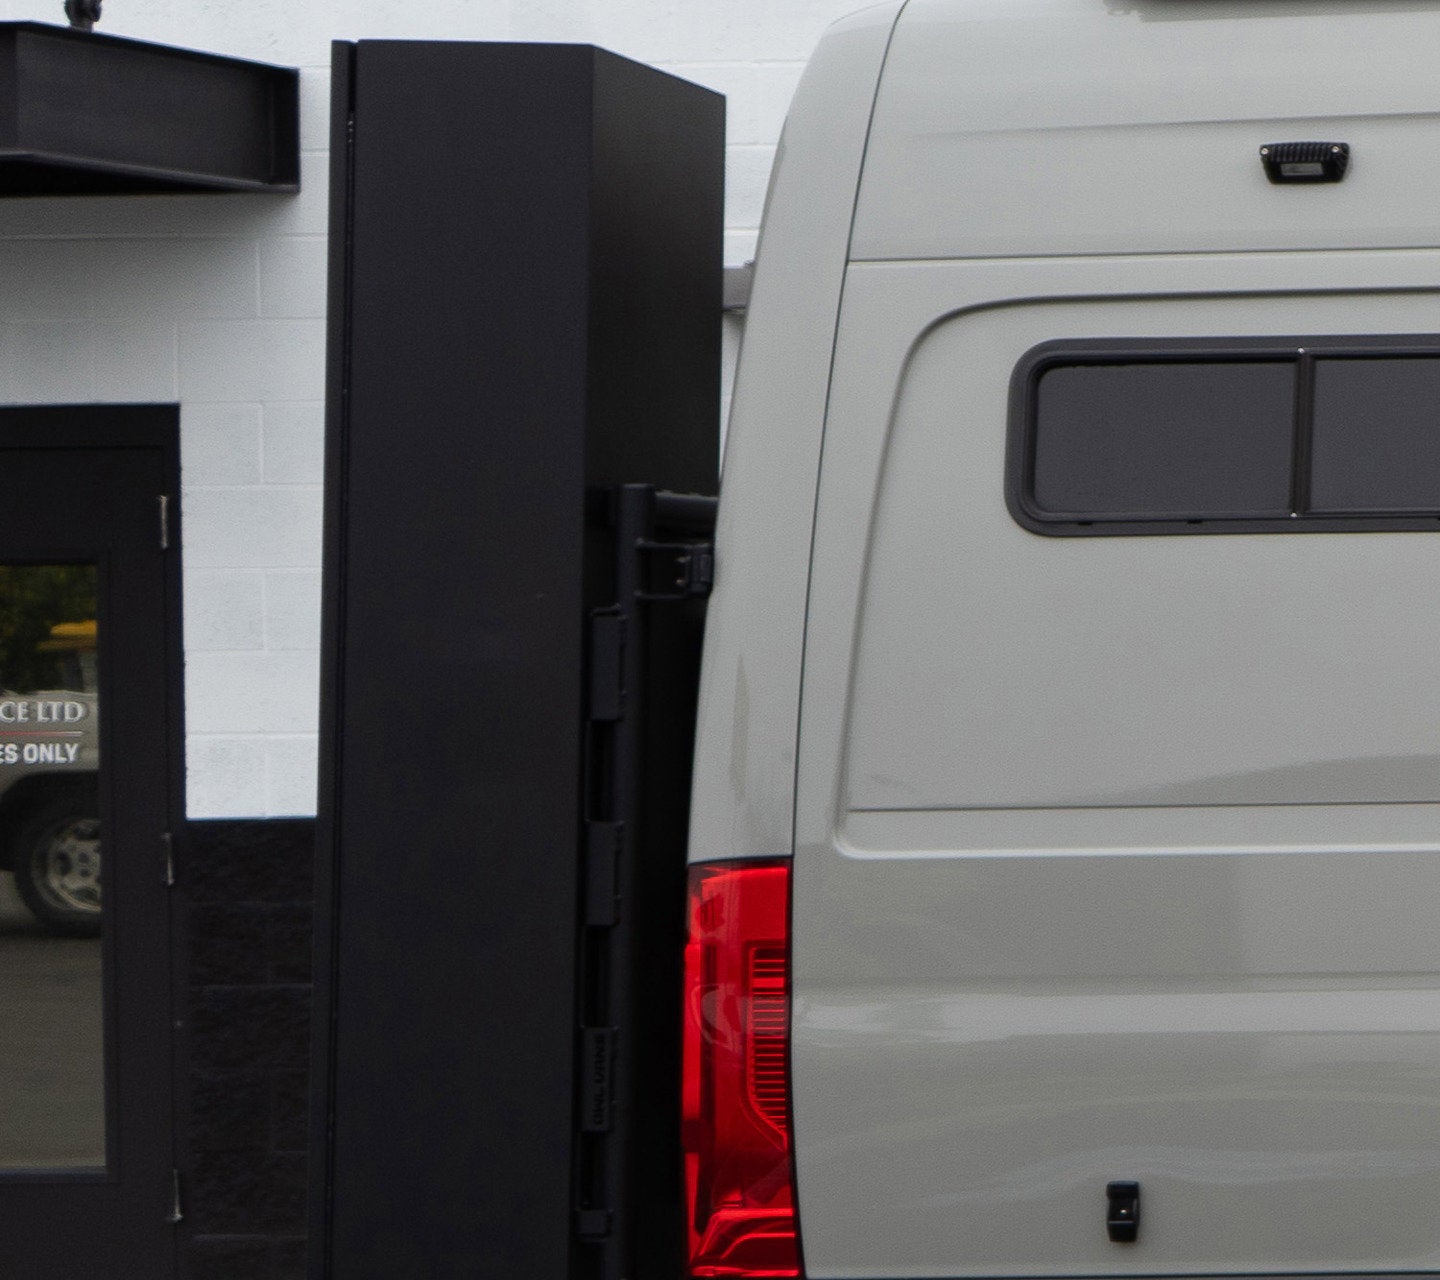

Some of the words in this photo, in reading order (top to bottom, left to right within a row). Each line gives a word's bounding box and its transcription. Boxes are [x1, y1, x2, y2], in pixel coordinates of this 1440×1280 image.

[0, 701, 29, 723] CE
[36, 701, 84, 723] LTD
[23, 743, 79, 764] ONLY
